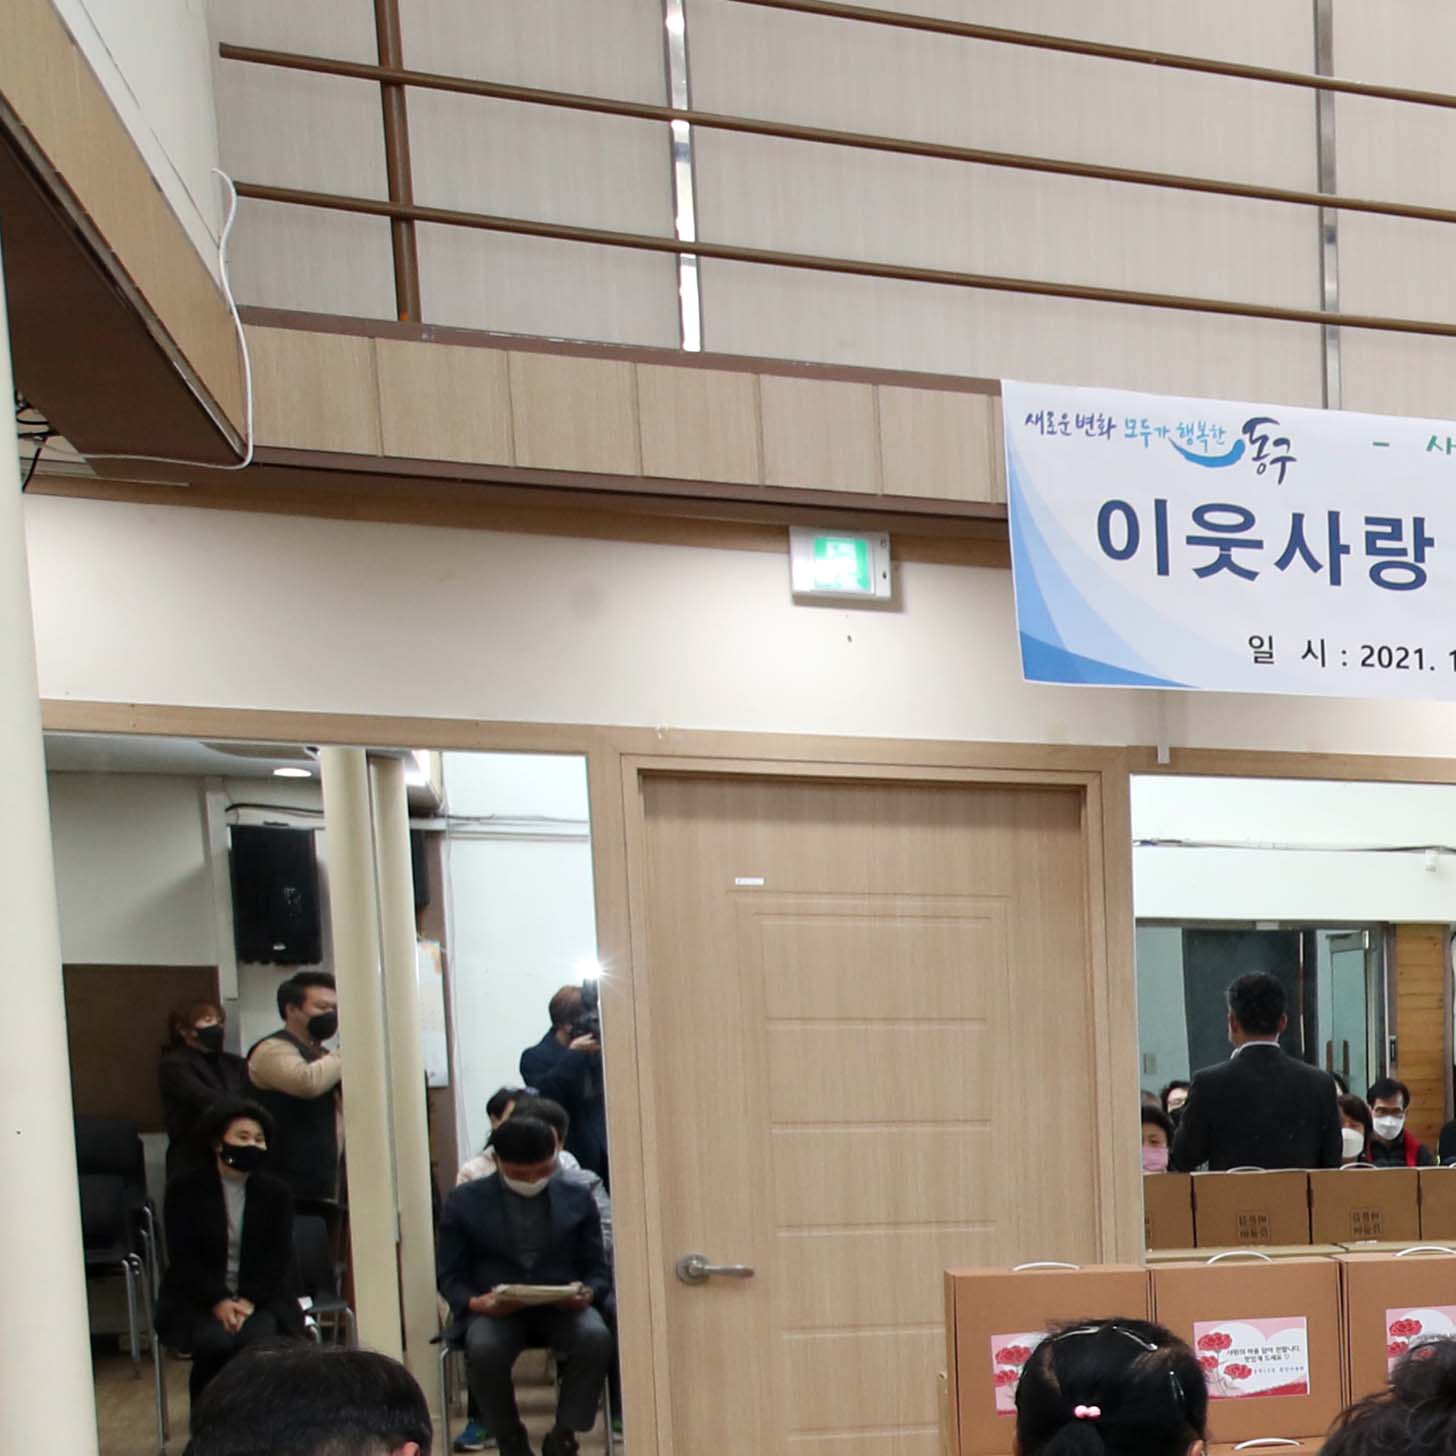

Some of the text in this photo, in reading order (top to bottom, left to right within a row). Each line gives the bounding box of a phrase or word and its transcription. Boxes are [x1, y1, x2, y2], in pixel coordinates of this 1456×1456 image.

[1075, 413, 1117, 440] 변화
[1176, 423, 1227, 453] 행복한
[1242, 416, 1297, 485] 동구
[1097, 498, 1435, 591] 이웃사랑
[1361, 644, 1435, 671] 2021.
